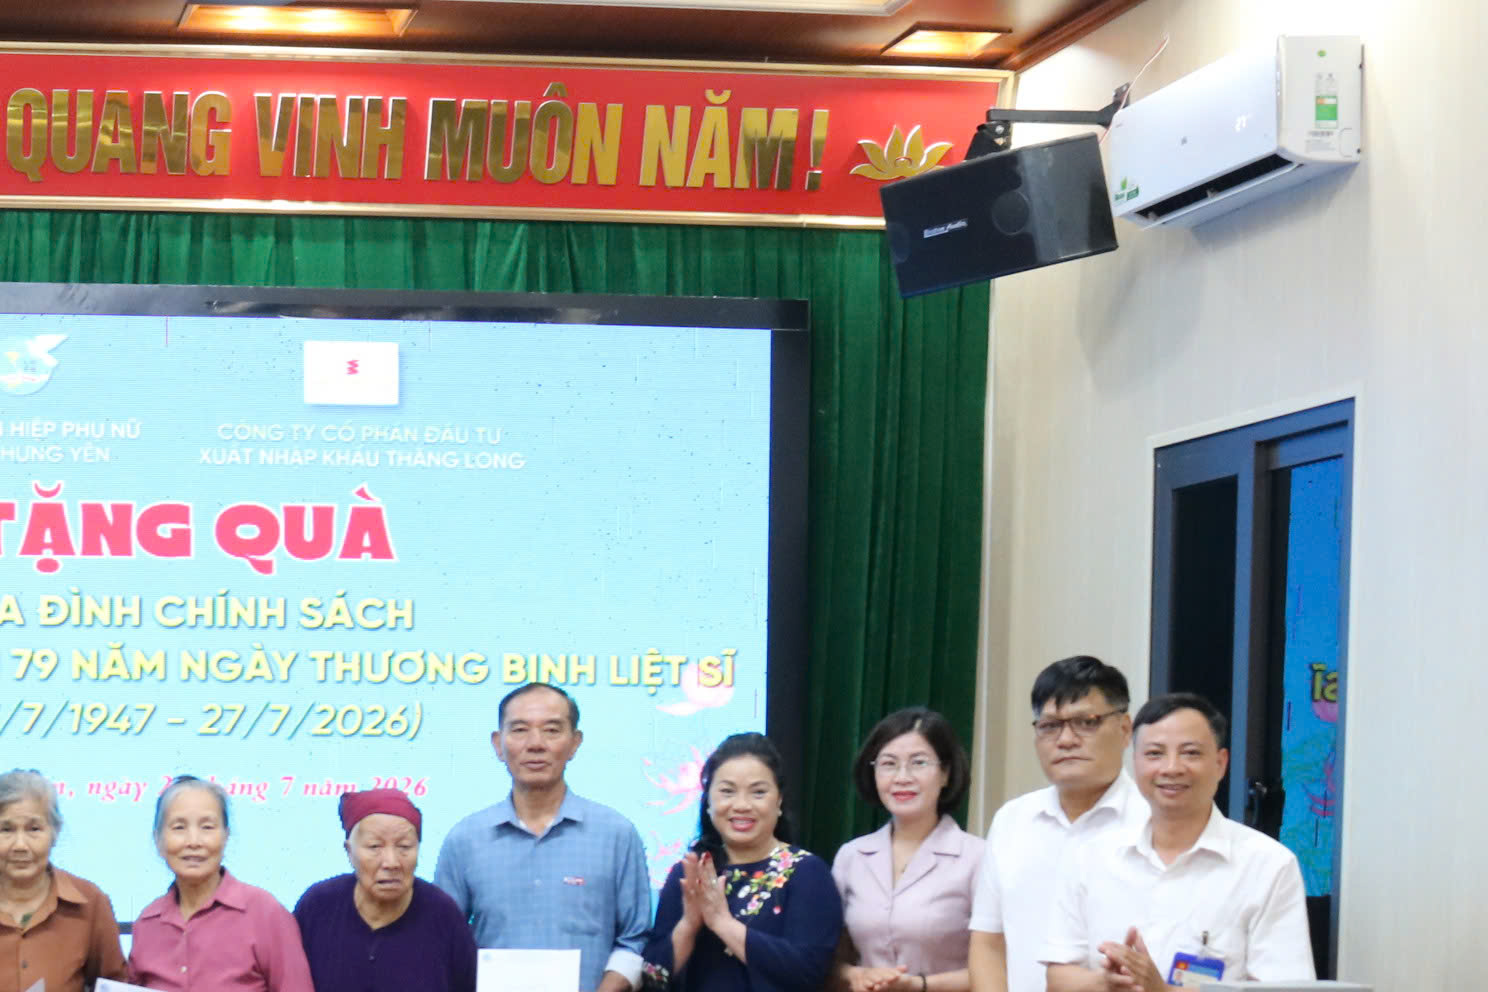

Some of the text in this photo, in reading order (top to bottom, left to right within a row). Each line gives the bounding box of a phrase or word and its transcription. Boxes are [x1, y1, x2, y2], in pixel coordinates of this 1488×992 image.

[6, 88, 232, 182] QUANG
[253, 93, 407, 179] VINH
[424, 82, 624, 185] MUÔN
[290, 423, 317, 441] TY
[464, 450, 528, 470] LONG
[213, 484, 397, 576] QUÀ
[37, 587, 142, 628] ĐÌNH
[153, 588, 288, 630] CHÍNH
[298, 588, 415, 631] SÁCH
[10, 648, 60, 681] 79
[70, 641, 167, 682] NĂM
[178, 641, 300, 683] NGÀY
[308, 648, 490, 685] THƯƠNG
[502, 652, 597, 687] BINH
[608, 647, 689, 696] LIỆT
[697, 647, 738, 688] SĨ
[196, 699, 424, 742] 27/7/2026)
[279, 775, 295, 796] 7
